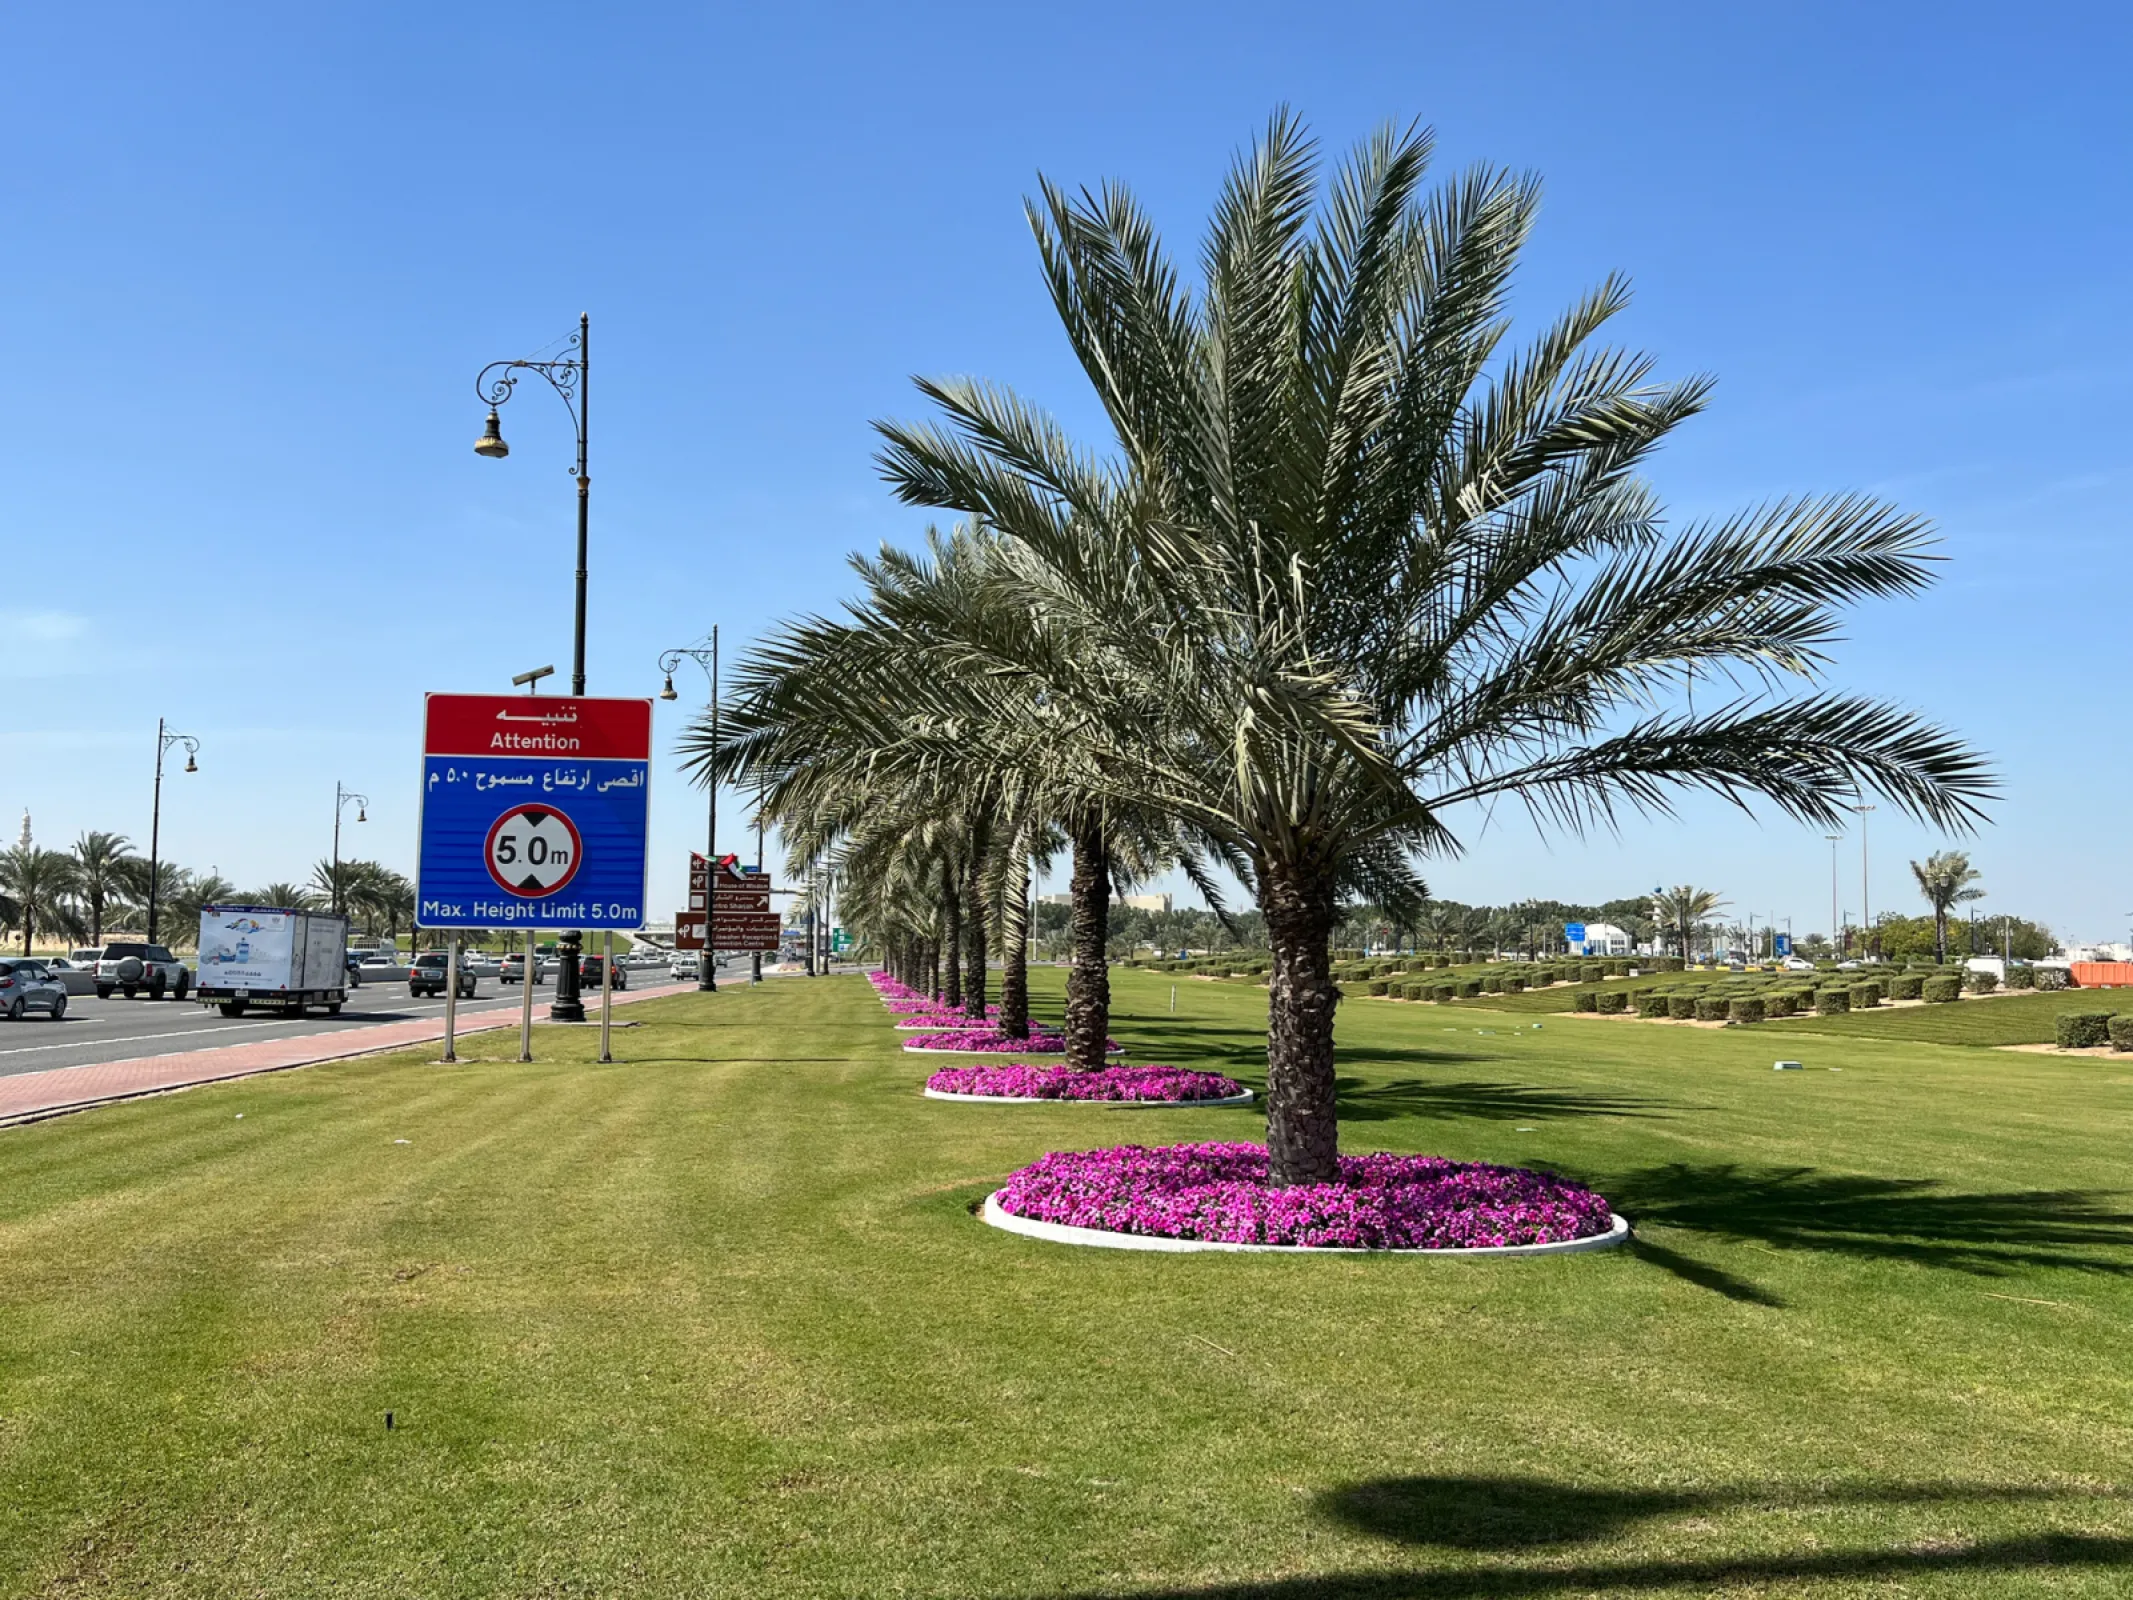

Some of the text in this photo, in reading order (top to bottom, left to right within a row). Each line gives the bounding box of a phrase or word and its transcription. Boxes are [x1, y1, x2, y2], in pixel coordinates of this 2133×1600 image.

[496, 706, 578, 727] تنبيه
[490, 732, 580, 750] Attention
[428, 771, 440, 792] م
[475, 769, 534, 790] مسموح
[542, 767, 591, 792] ارتفاع
[422, 900, 637, 921] Max. Height Limit 5.0m
